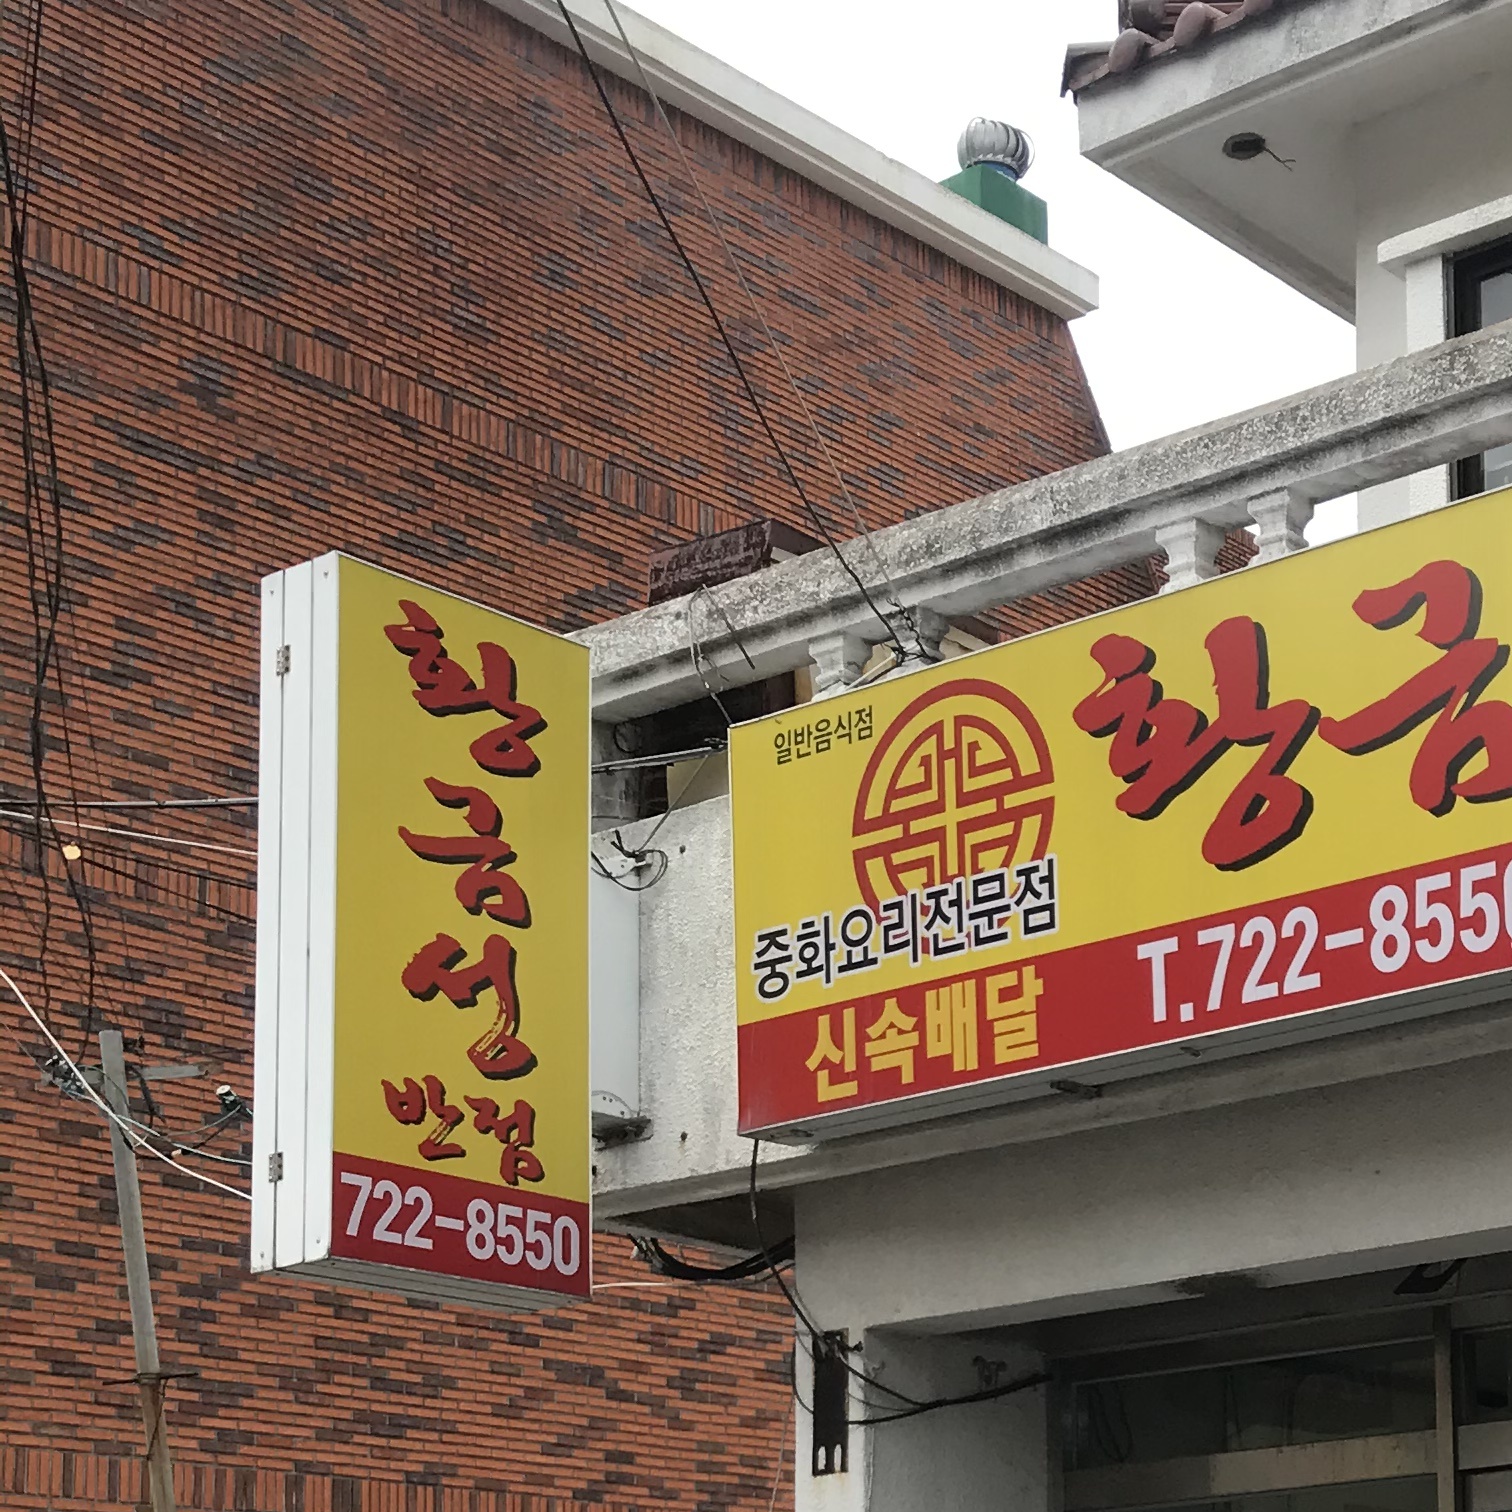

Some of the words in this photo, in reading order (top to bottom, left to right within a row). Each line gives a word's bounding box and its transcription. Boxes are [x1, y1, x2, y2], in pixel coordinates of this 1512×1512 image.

[774, 705, 875, 766] 일반음식점
[753, 857, 1058, 1000] 중화요리전문점
[805, 964, 1044, 1103] 신속배달
[381, 1073, 545, 1187] 반점
[339, 1172, 582, 1277] 722-8550
